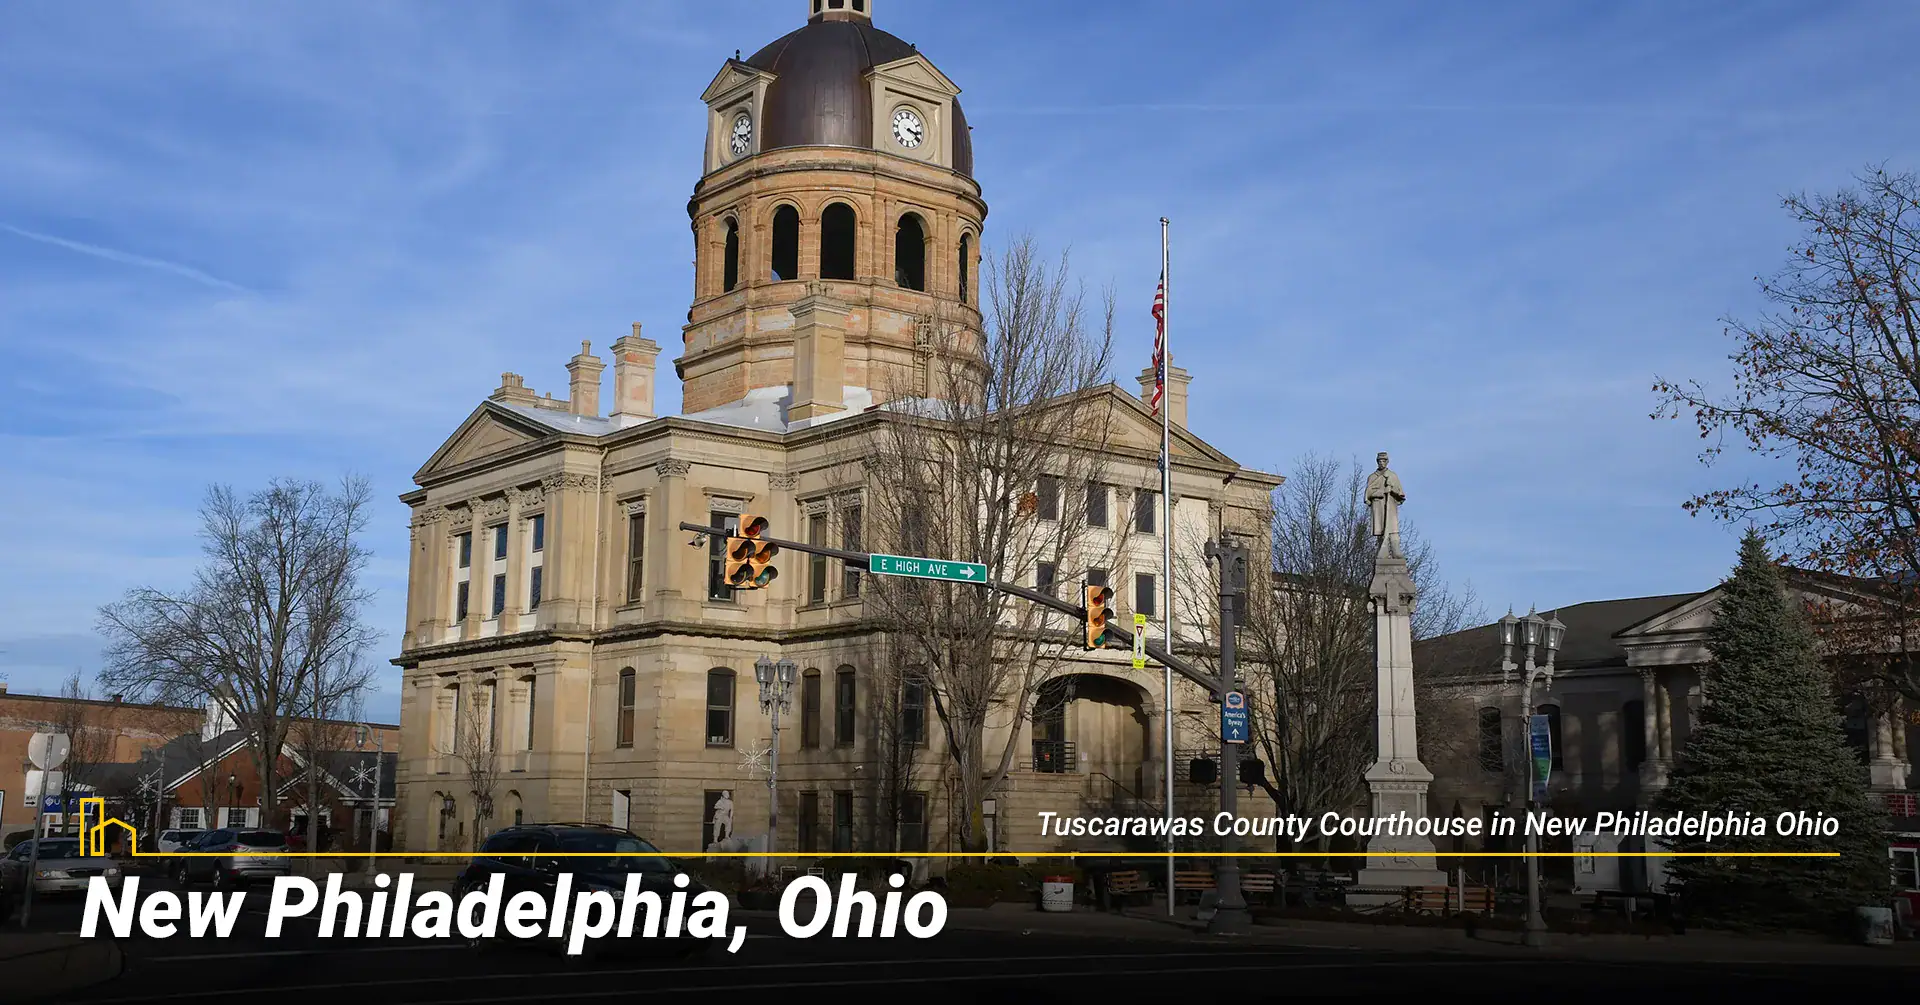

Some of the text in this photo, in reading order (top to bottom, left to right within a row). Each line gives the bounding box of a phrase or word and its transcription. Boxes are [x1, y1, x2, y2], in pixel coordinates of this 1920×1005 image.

[881, 559, 948, 576] E HIGH AVE
[1227, 718, 1243, 727] Byway
